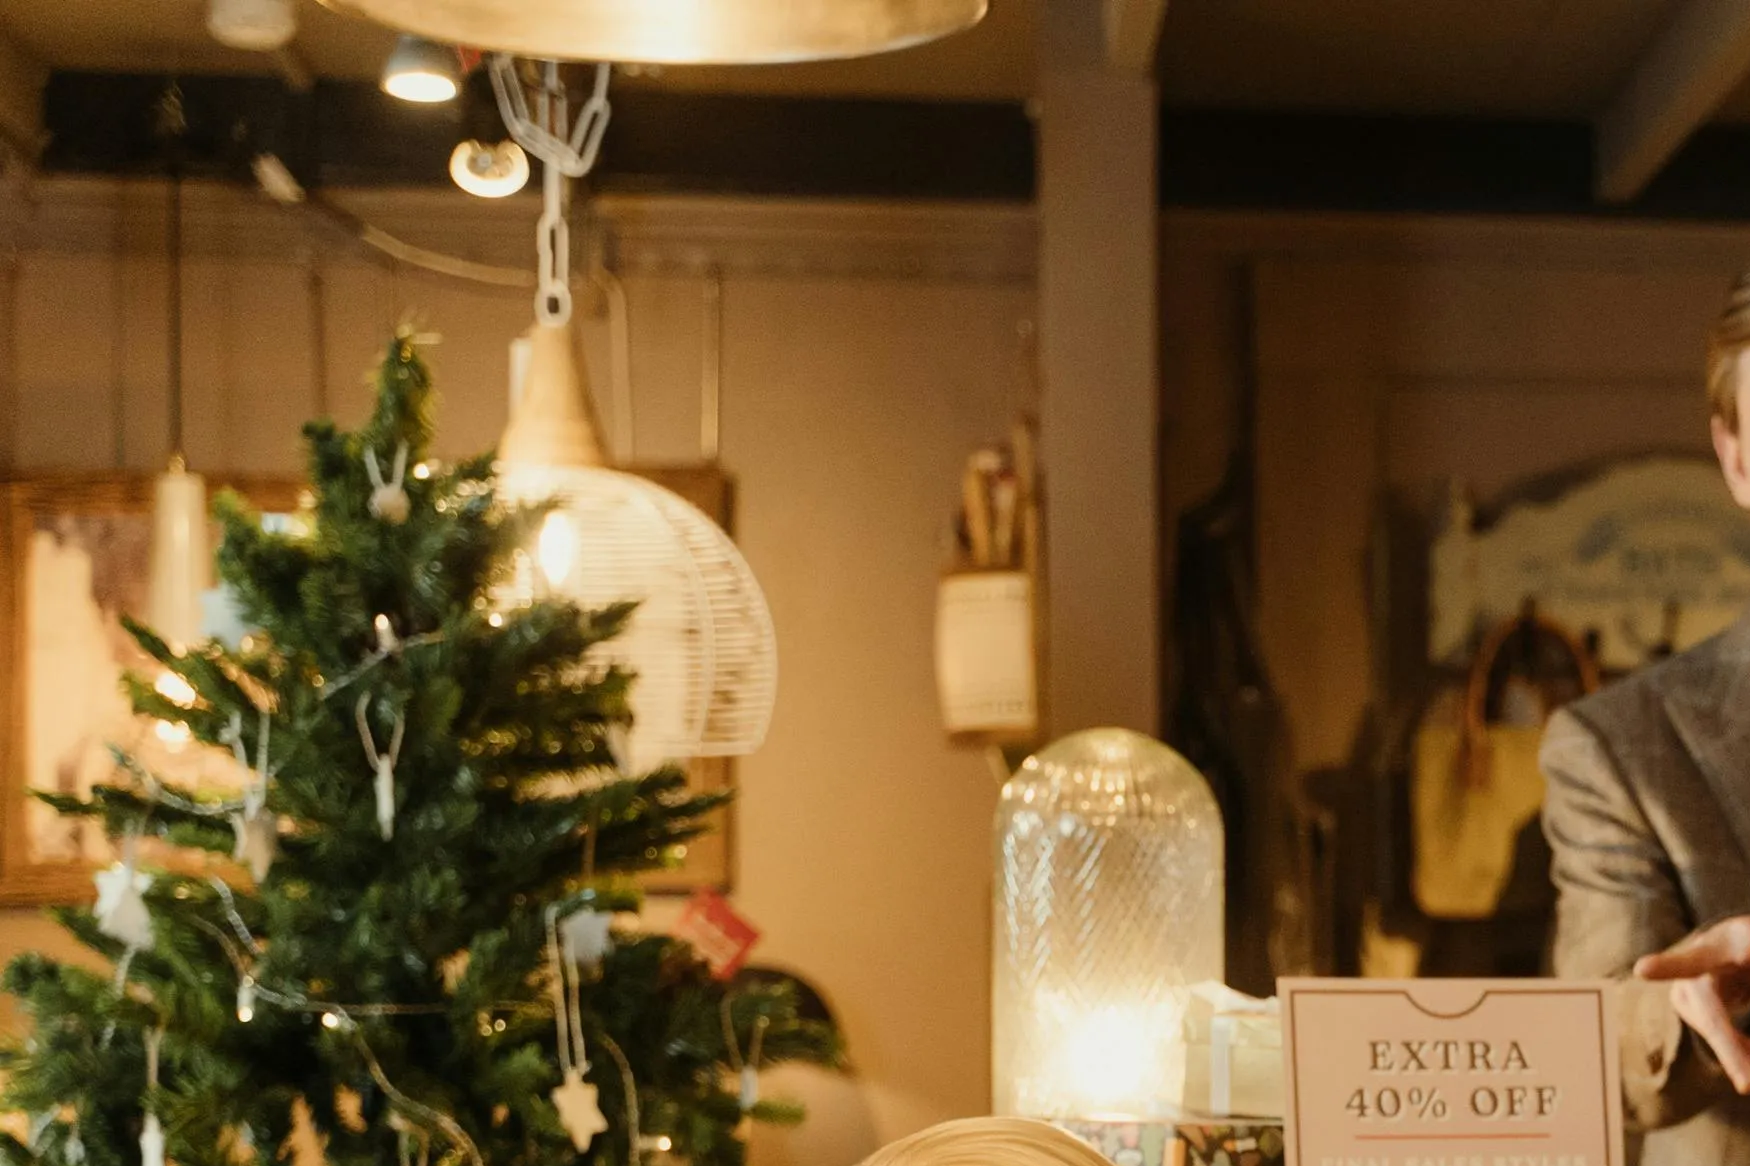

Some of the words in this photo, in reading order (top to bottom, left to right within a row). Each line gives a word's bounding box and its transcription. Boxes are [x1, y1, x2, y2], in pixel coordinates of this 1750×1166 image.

[1368, 1039, 1531, 1071] EXTRA
[1345, 1086, 1447, 1118] 40%
[1470, 1086, 1558, 1117] OFF
